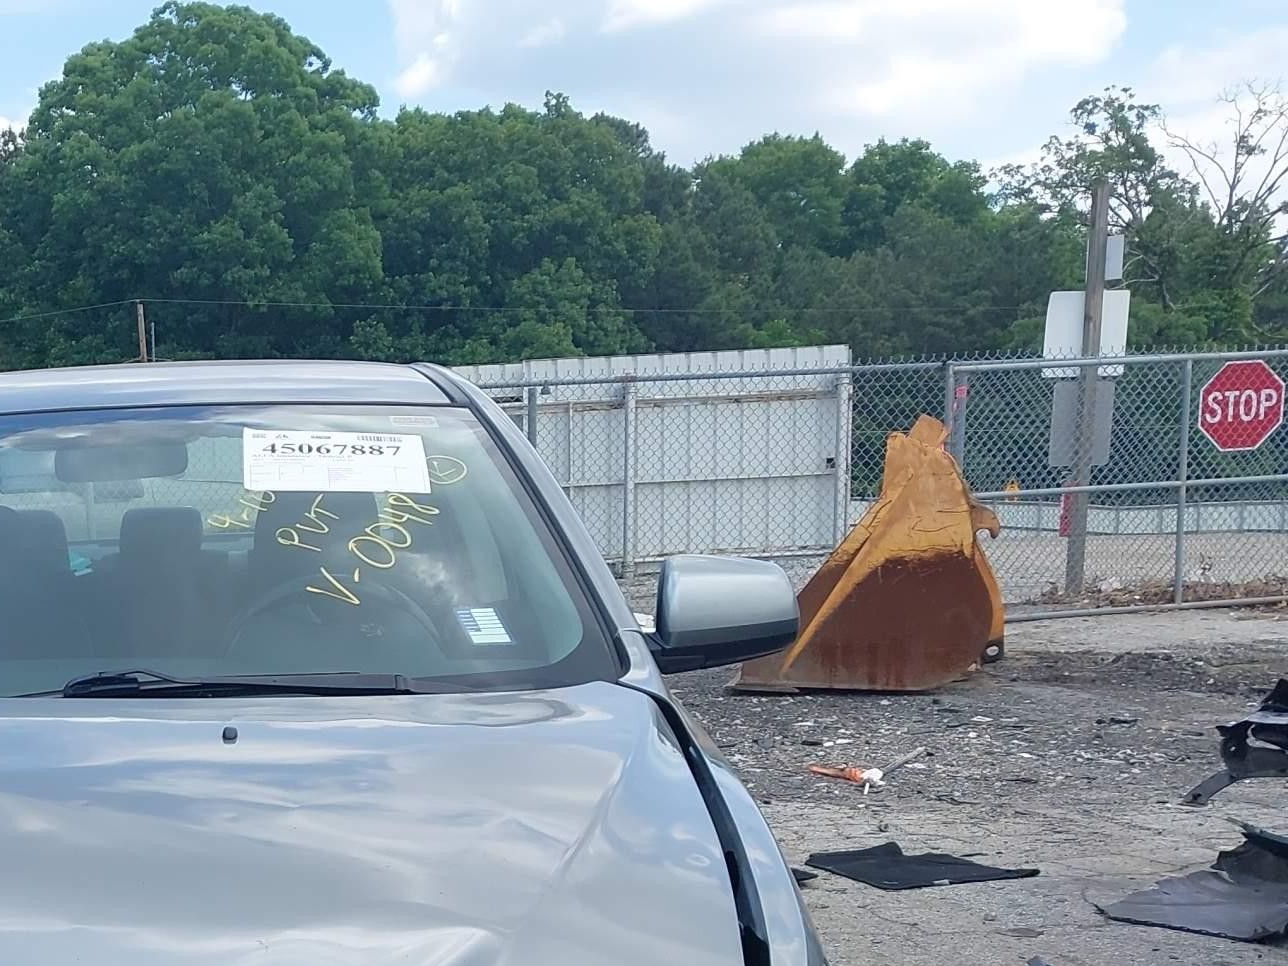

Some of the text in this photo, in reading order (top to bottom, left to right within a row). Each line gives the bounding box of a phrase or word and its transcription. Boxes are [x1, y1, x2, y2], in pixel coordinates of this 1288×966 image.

[1205, 388, 1278, 424] STOP
[262, 443, 401, 456] 45067887
[277, 494, 339, 552] PVT
